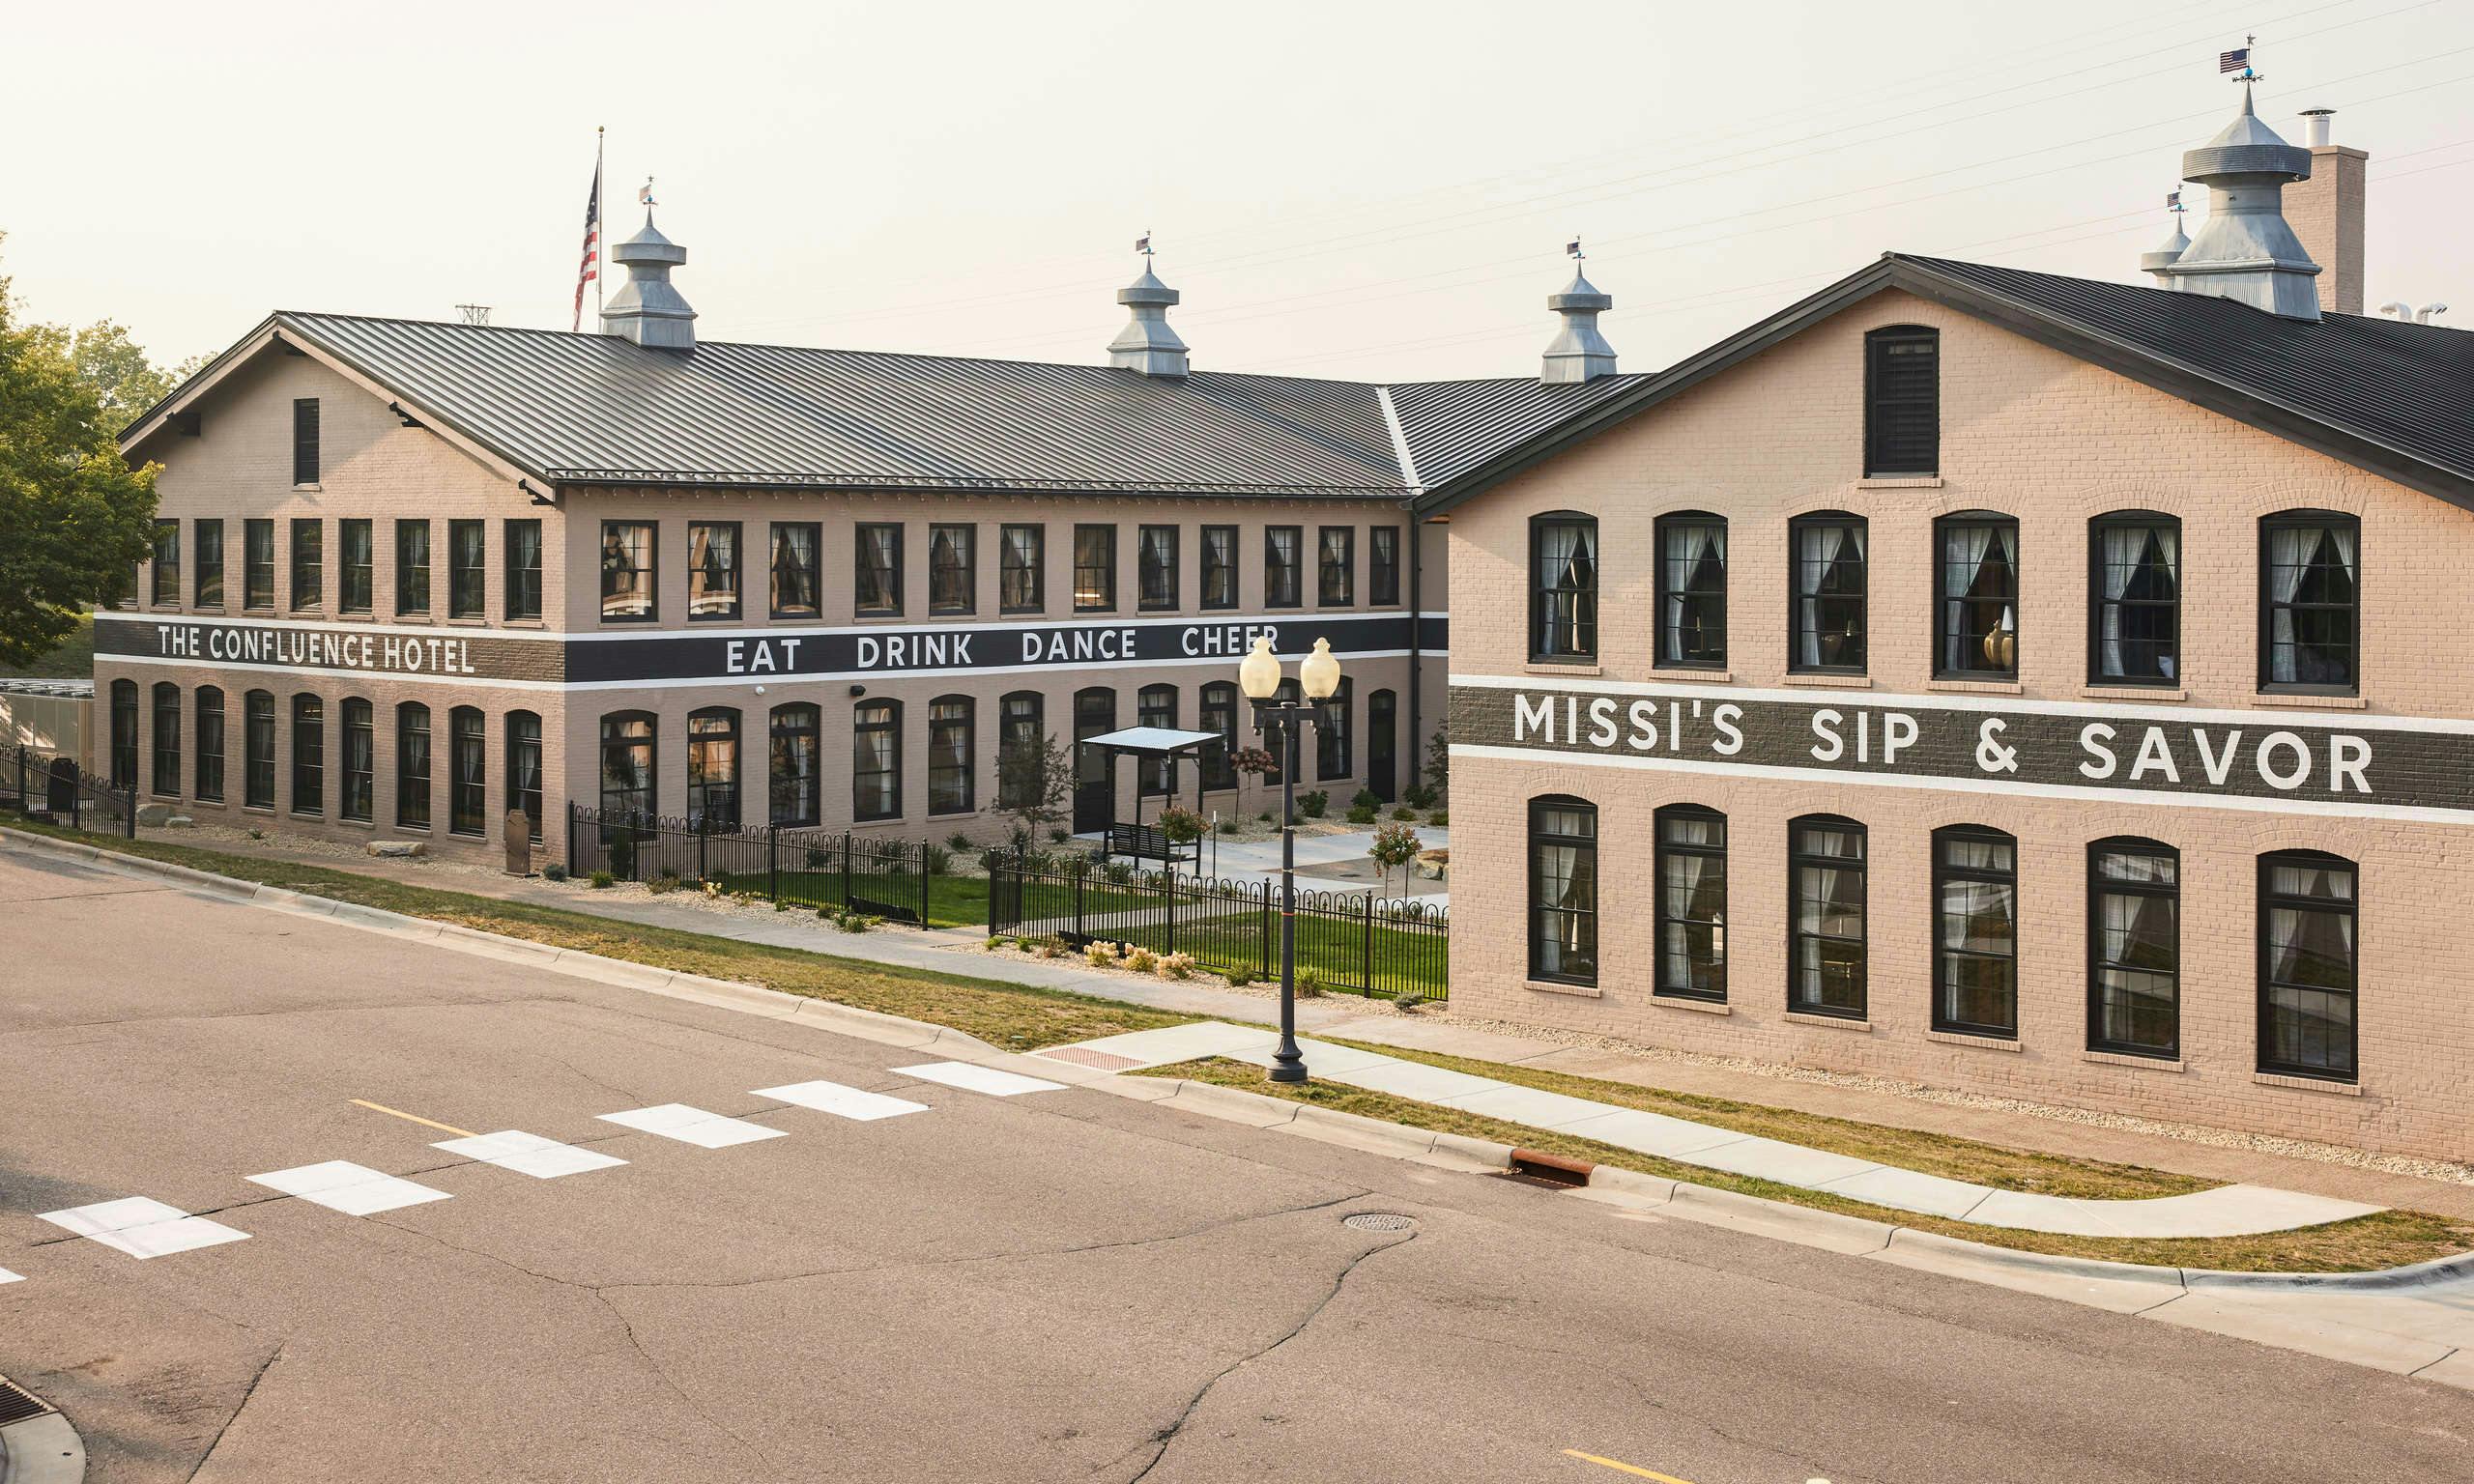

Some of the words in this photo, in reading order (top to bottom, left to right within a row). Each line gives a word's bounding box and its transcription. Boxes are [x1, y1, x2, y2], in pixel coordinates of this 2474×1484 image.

[158, 625, 200, 656] THE
[210, 628, 374, 668] CONFLUENCE
[384, 638, 475, 673] HOTEL
[727, 639, 801, 673] EAT
[857, 634, 973, 669] DRINK
[1022, 629, 1136, 662] DANCE
[1181, 625, 1279, 656] CHEER
[1513, 694, 1744, 756] MISSI'S
[1809, 708, 1920, 764] SIP
[1975, 717, 2019, 774] &
[2078, 723, 2373, 794] SAVOR
